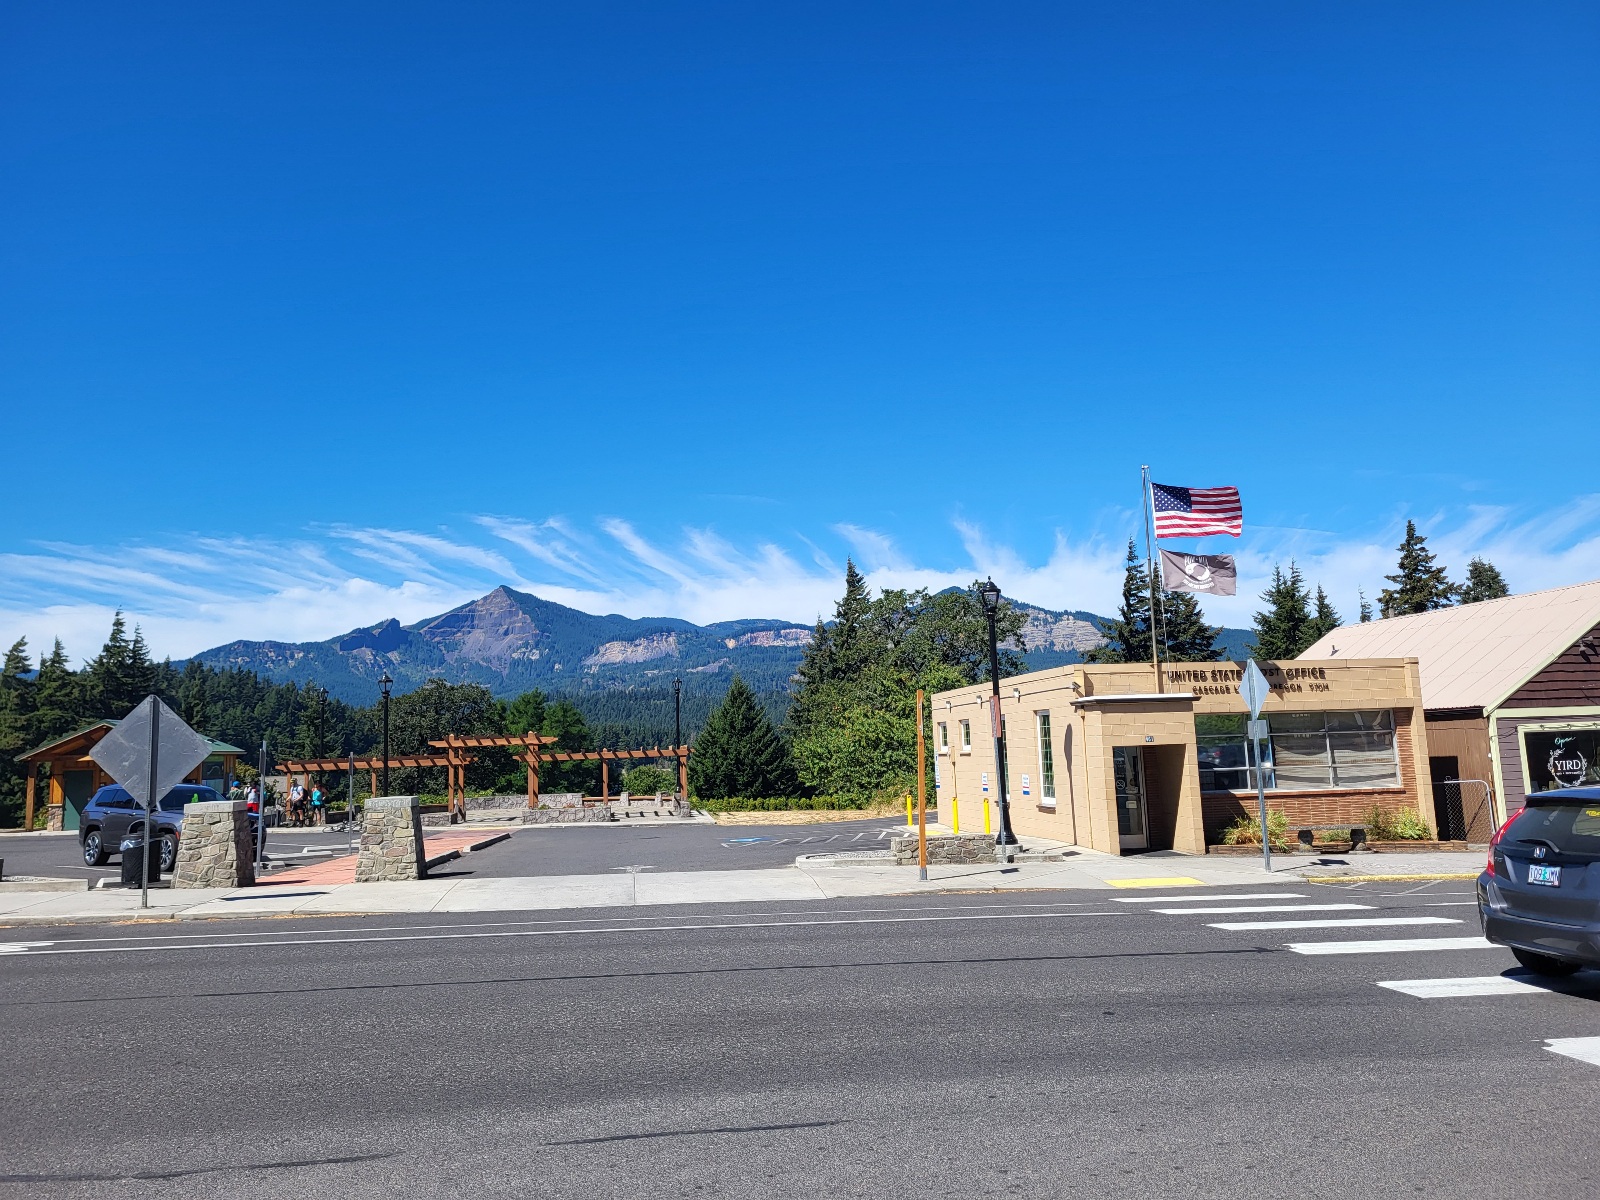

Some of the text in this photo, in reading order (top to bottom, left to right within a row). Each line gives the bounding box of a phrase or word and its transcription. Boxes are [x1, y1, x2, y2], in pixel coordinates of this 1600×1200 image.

[1167, 667, 1326, 682] UNITED STATE OST OFFICE
[1192, 685, 1231, 695] CASCADE
[1554, 759, 1581, 771] YIRD
